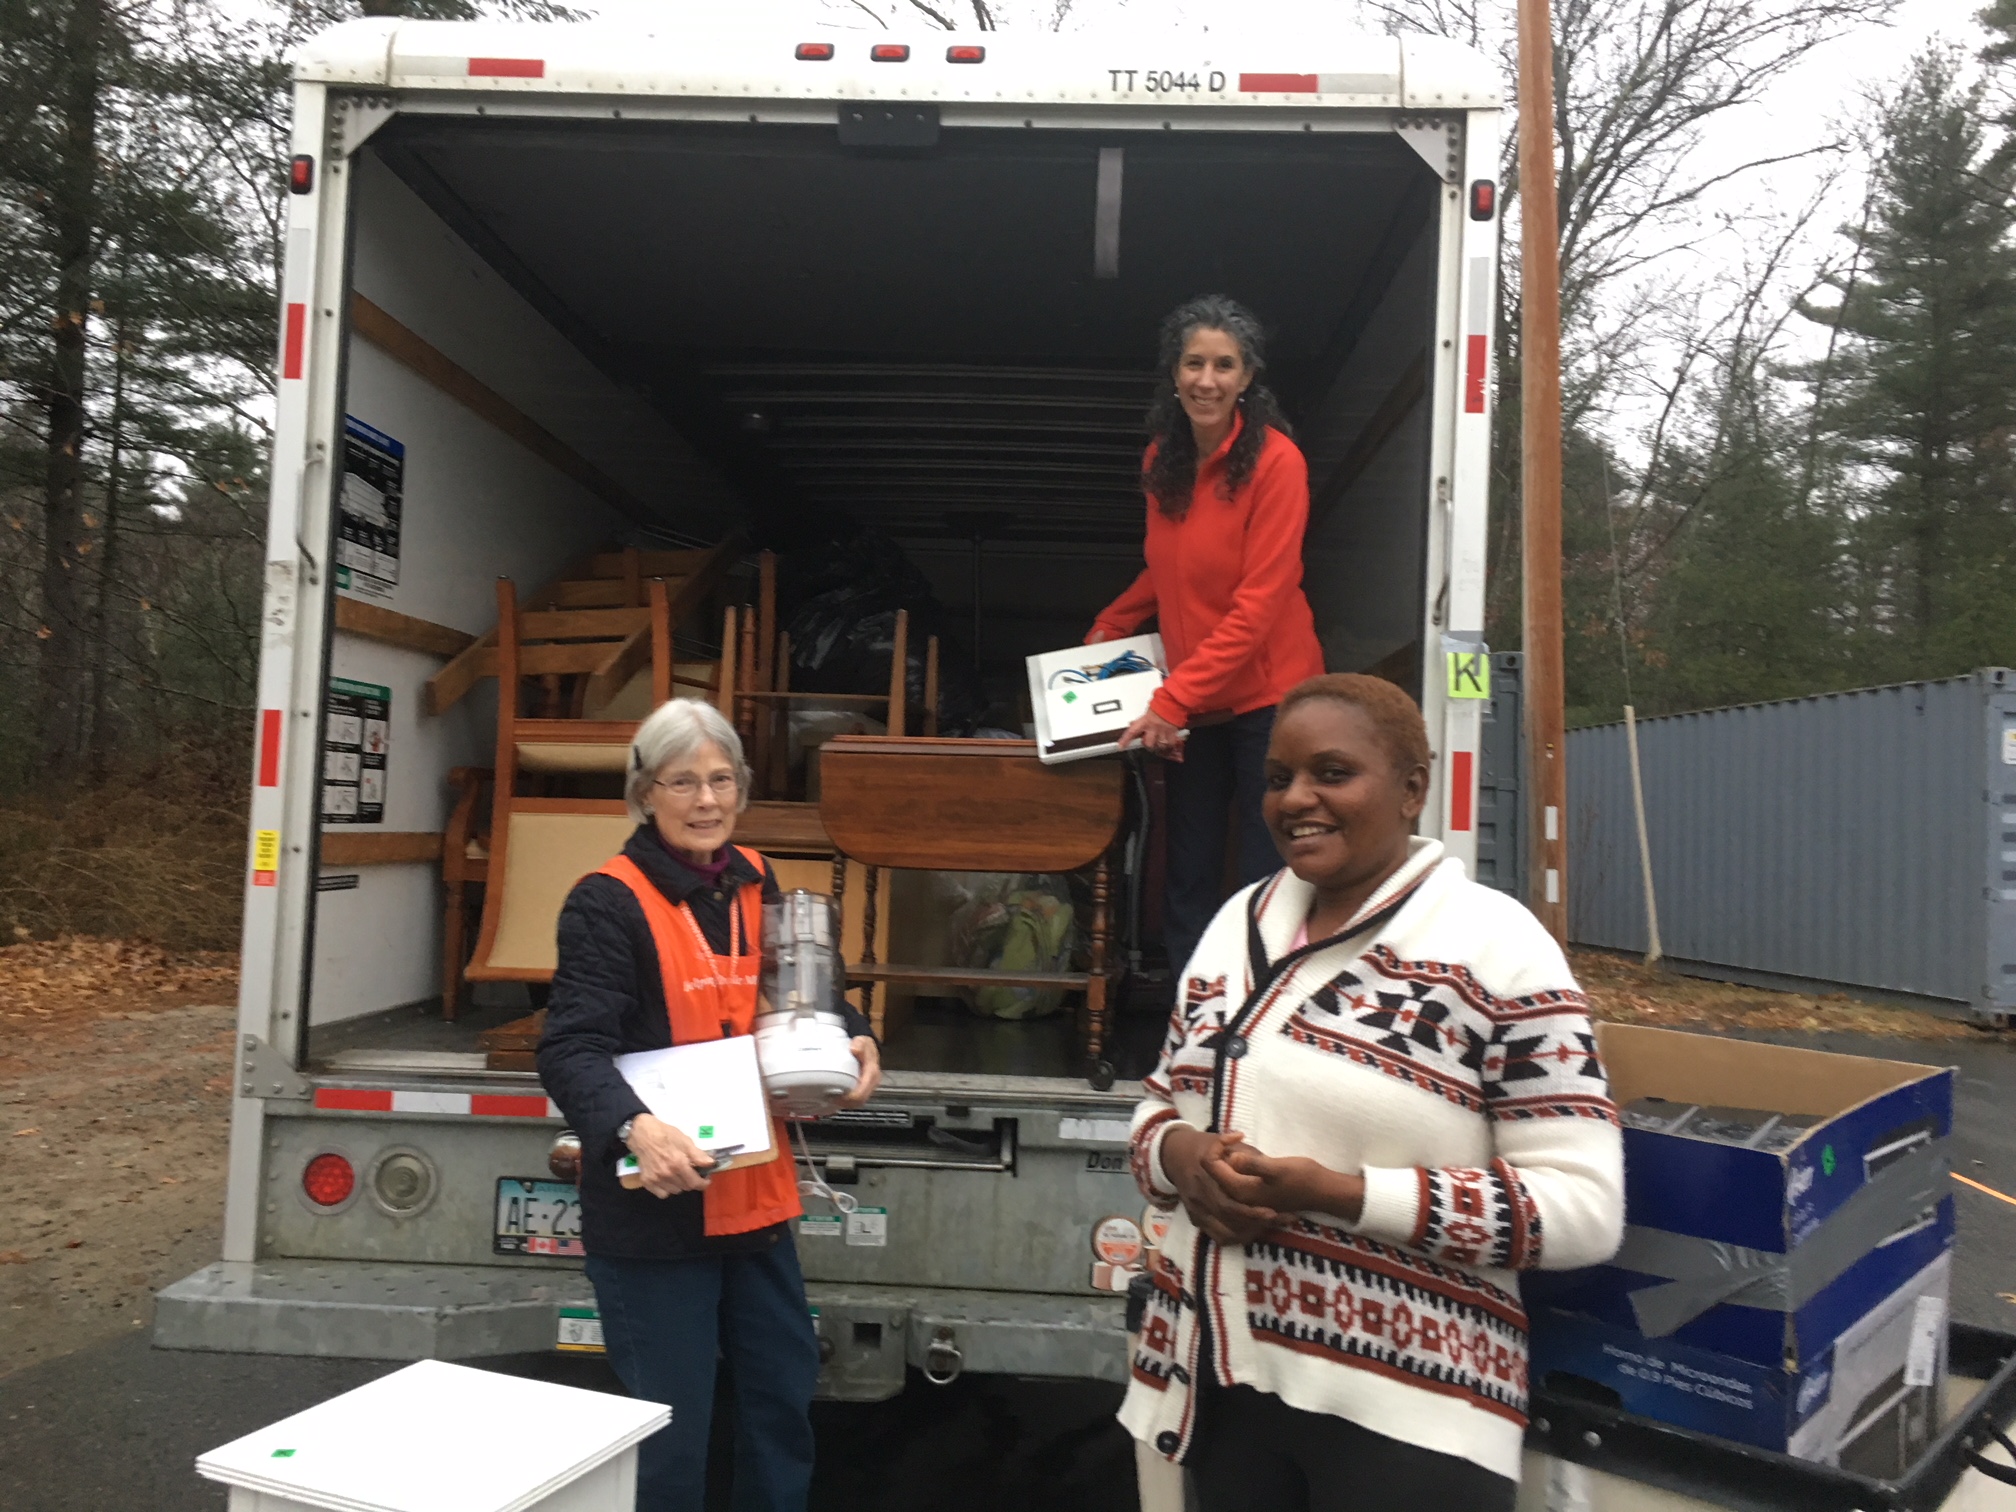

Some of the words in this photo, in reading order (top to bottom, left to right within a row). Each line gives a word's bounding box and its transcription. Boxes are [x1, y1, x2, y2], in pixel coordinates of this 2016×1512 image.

[1108, 69, 1138, 92] TT
[1145, 70, 1201, 93] 5044
[1209, 70, 1226, 92] D
[1453, 652, 1482, 692] K
